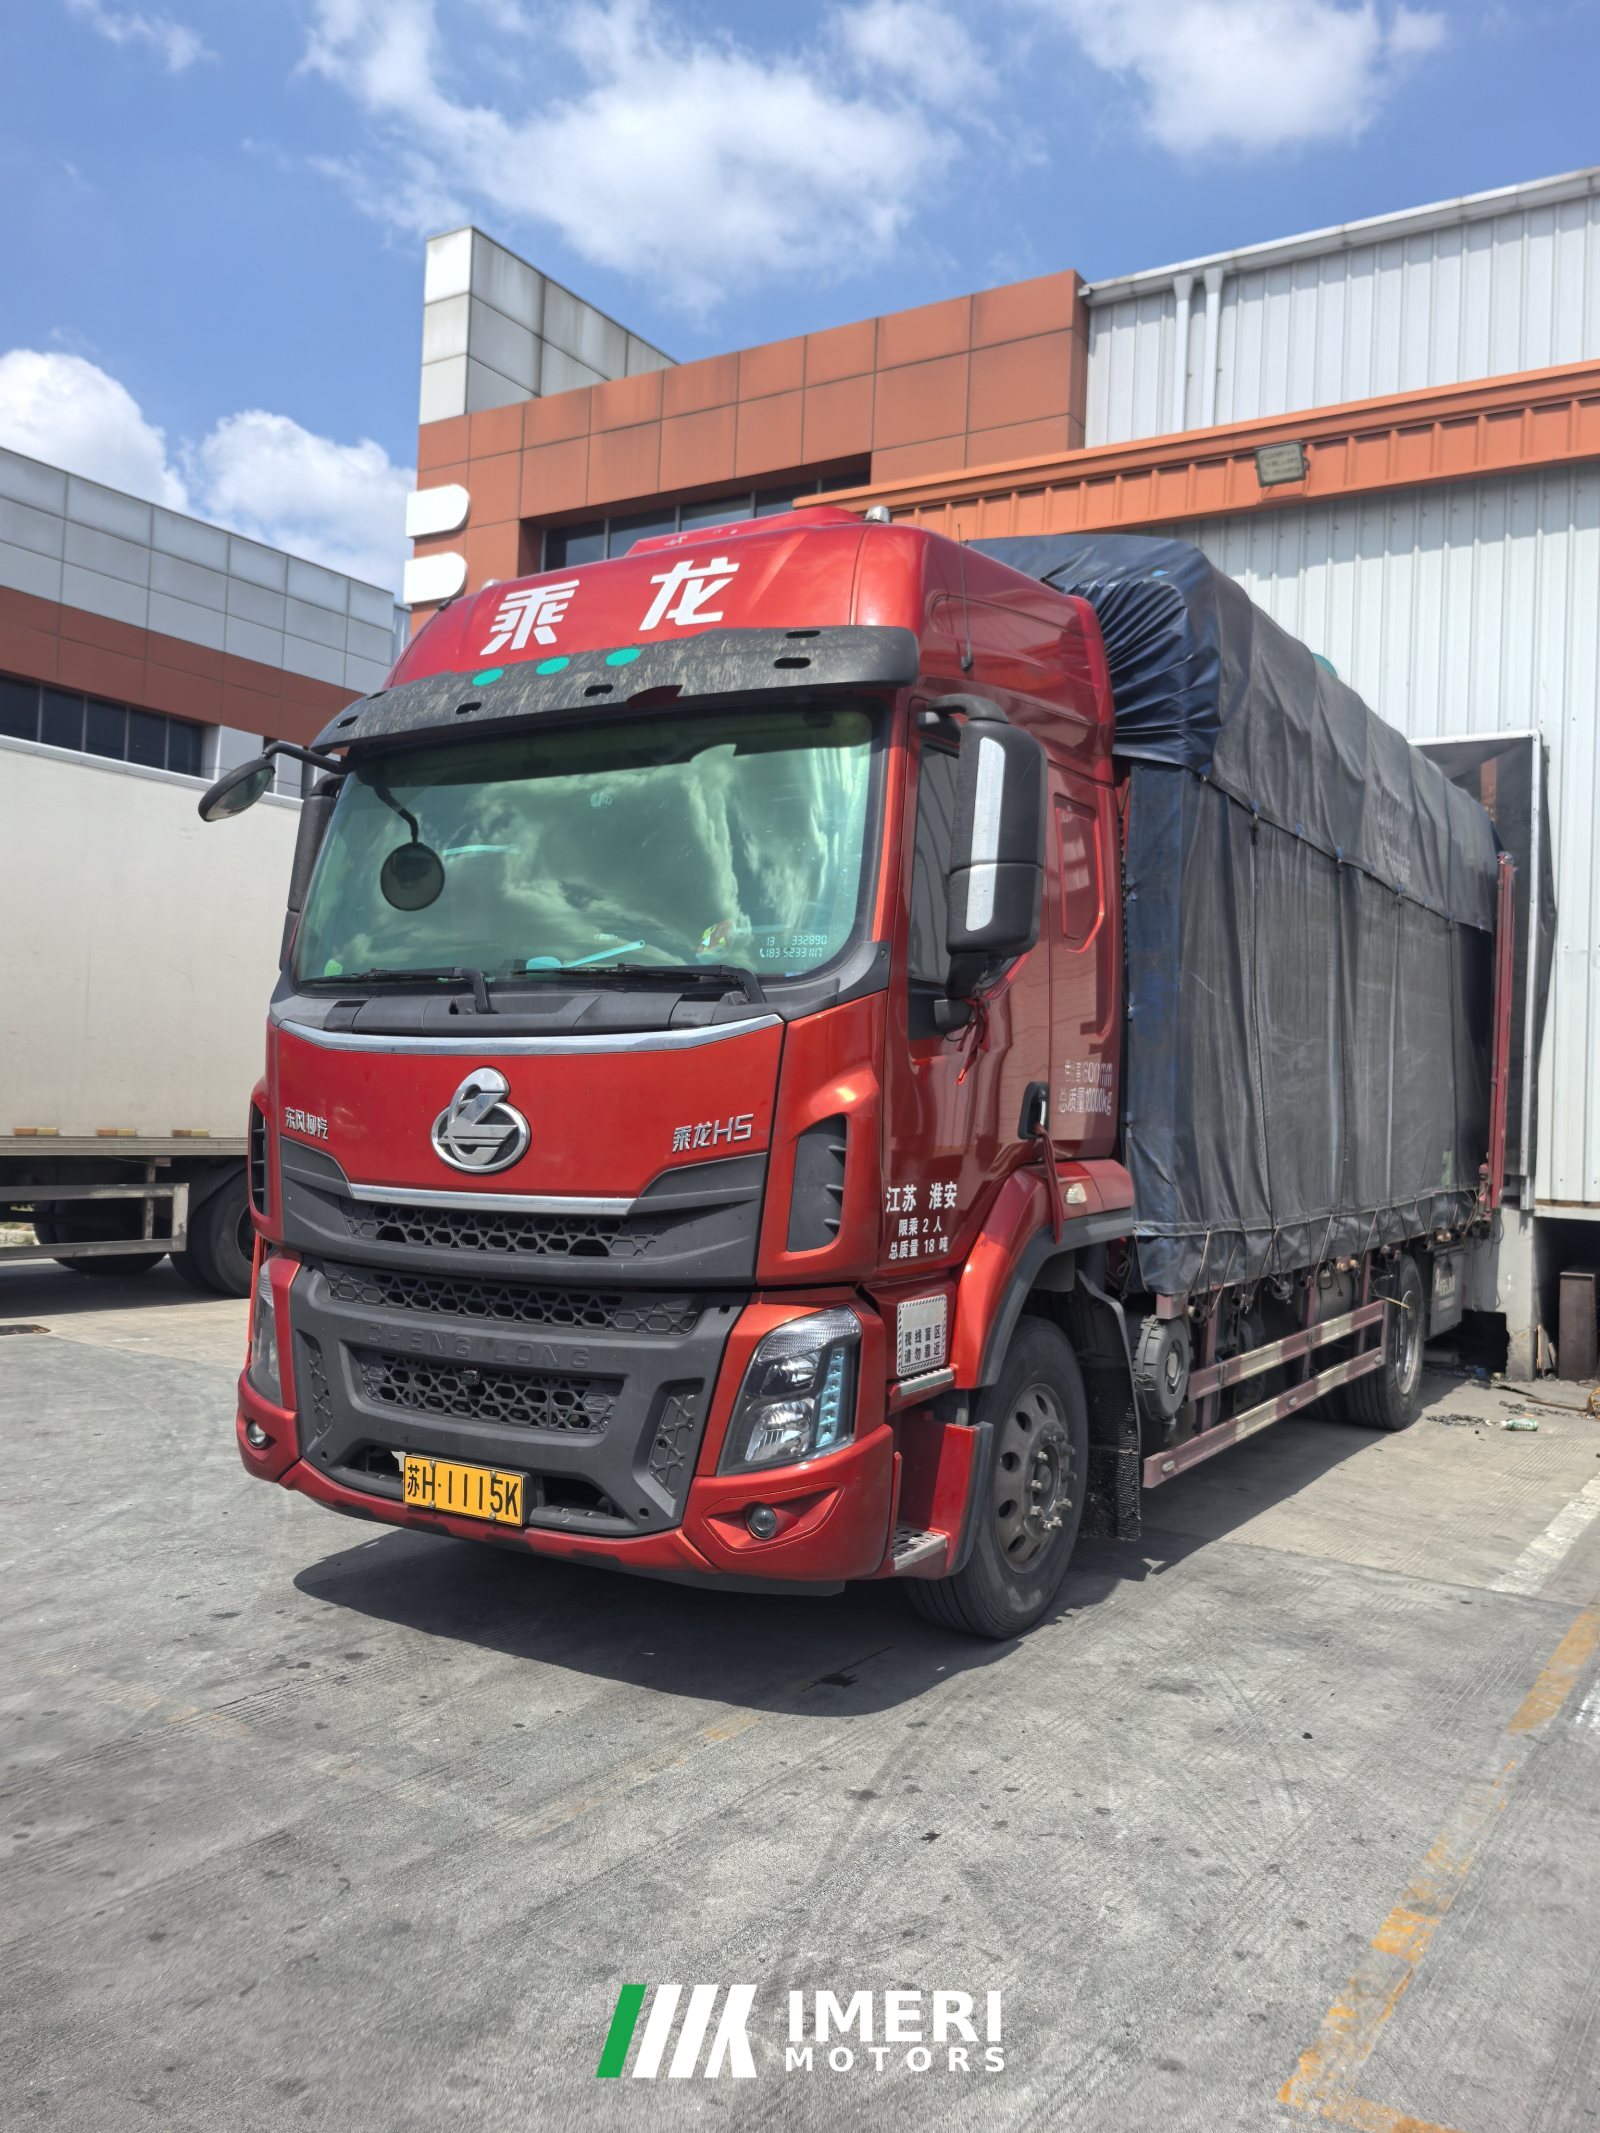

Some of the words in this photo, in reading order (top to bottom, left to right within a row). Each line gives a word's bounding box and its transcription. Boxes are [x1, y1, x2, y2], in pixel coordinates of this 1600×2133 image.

[480, 557, 740, 655] 乘龙
[792, 935, 828, 945] 332890
[285, 1106, 328, 1140] 东风柳汽
[672, 1113, 754, 1152] 乘龙H5
[885, 1184, 917, 1213] 江苏
[928, 1181, 957, 1210] 淮安
[898, 1217, 918, 1237] 限乘
[922, 1218, 929, 1233] 2
[932, 1215, 942, 1233] 人
[888, 1239, 918, 1260] 总质量
[924, 1239, 935, 1253] 18
[939, 1236, 948, 1252] 吨
[367, 1323, 472, 1359] CHENG
[494, 1338, 591, 1369] LONG
